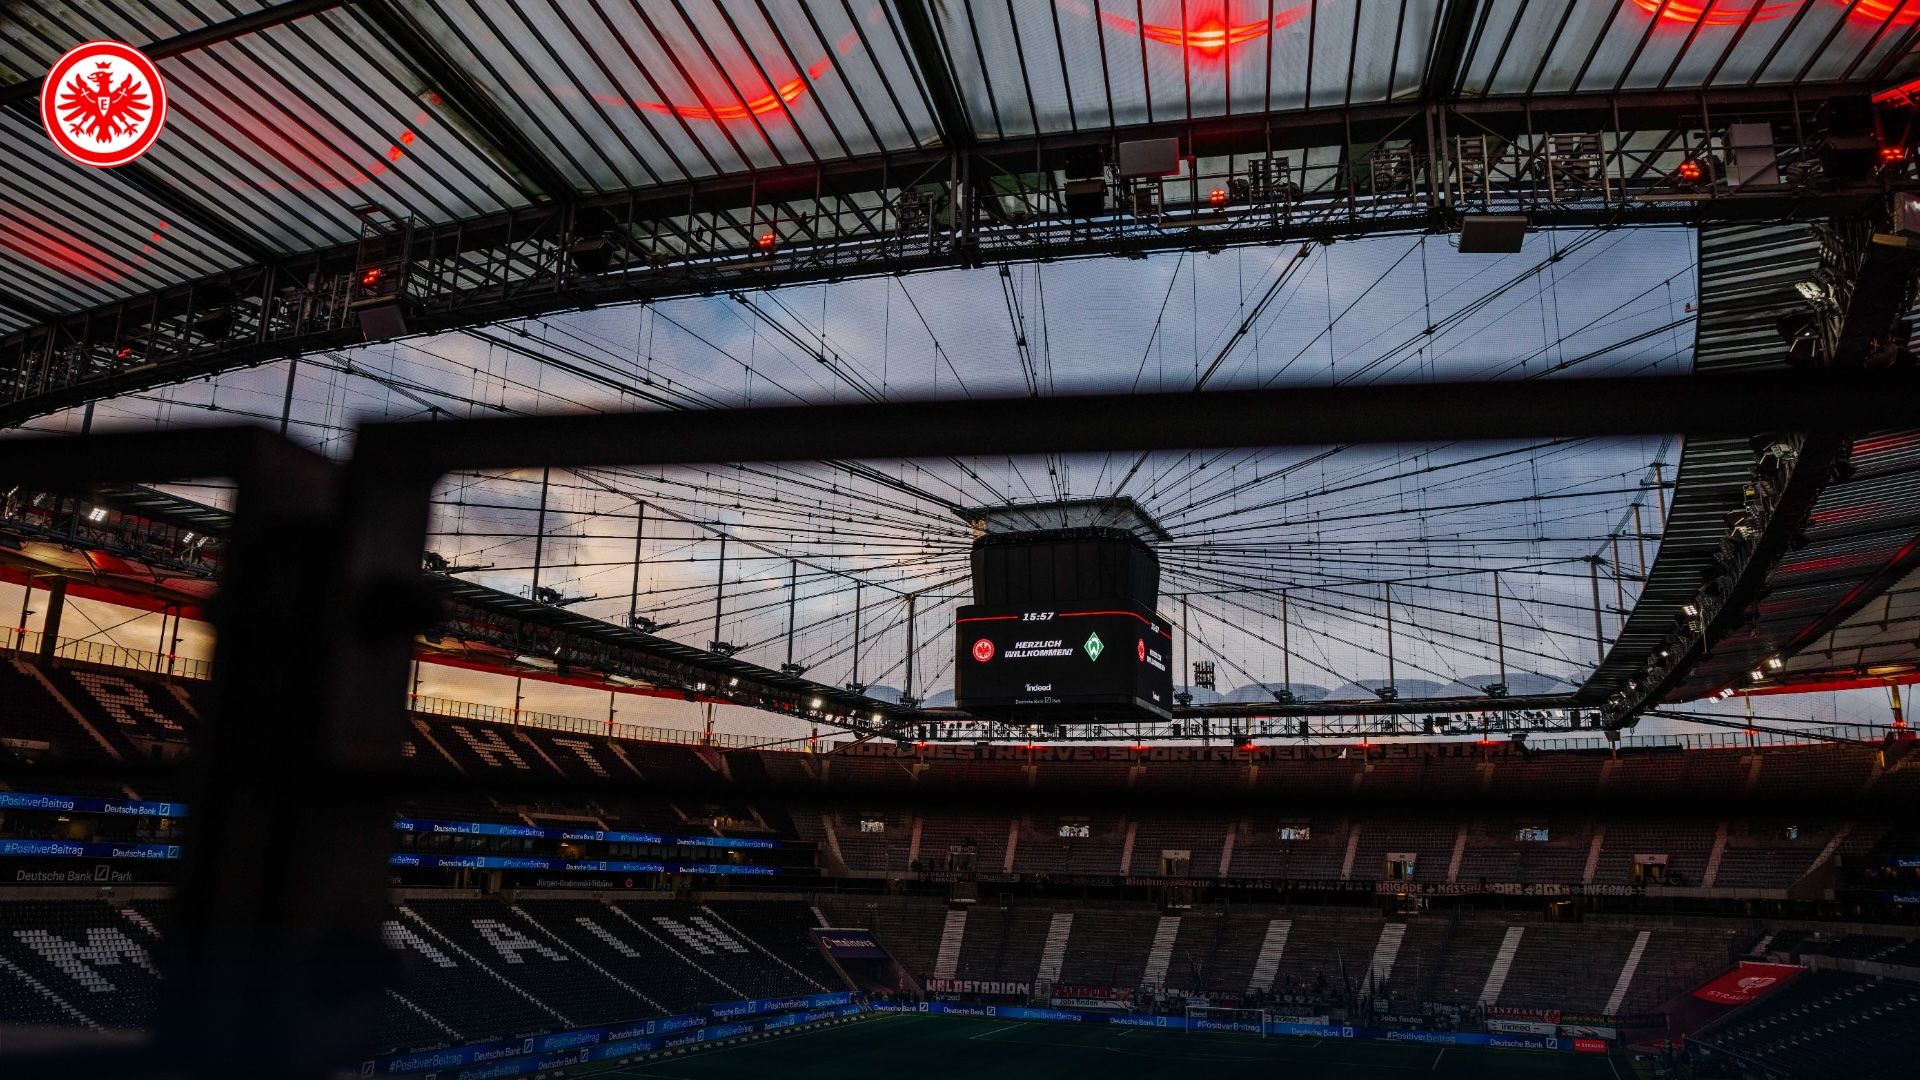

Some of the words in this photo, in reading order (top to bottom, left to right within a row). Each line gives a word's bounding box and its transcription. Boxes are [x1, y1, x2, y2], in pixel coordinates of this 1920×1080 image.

[1022, 612, 1055, 621] 15:57
[1015, 640, 1062, 649] HERZLICH
[1004, 648, 1073, 658] WILLKOMMEN!
[0, 795, 74, 810] PositiverBeitrag
[105, 804, 138, 815] Deutsche
[139, 806, 157, 815] Bank
[4, 843, 84, 857] #PositiverBeitrag
[112, 848, 146, 858] Deutsche
[146, 849, 165, 859] Bank
[16, 869, 65, 881] Deutsche
[67, 869, 92, 882] Bank
[110, 871, 133, 881] Park
[1375, 883, 1423, 894] BRIGADE
[1437, 883, 1480, 893] NASSAU
[1584, 884, 1632, 896] INFERNO
[926, 979, 1029, 994] WALDSTADION
[1501, 1023, 1531, 1032] indeed
[1490, 1039, 1523, 1048] Deutsche
[1524, 1040, 1543, 1049] Bank
[474, 1050, 505, 1062] Deutsche
[505, 1047, 521, 1057] Bank
